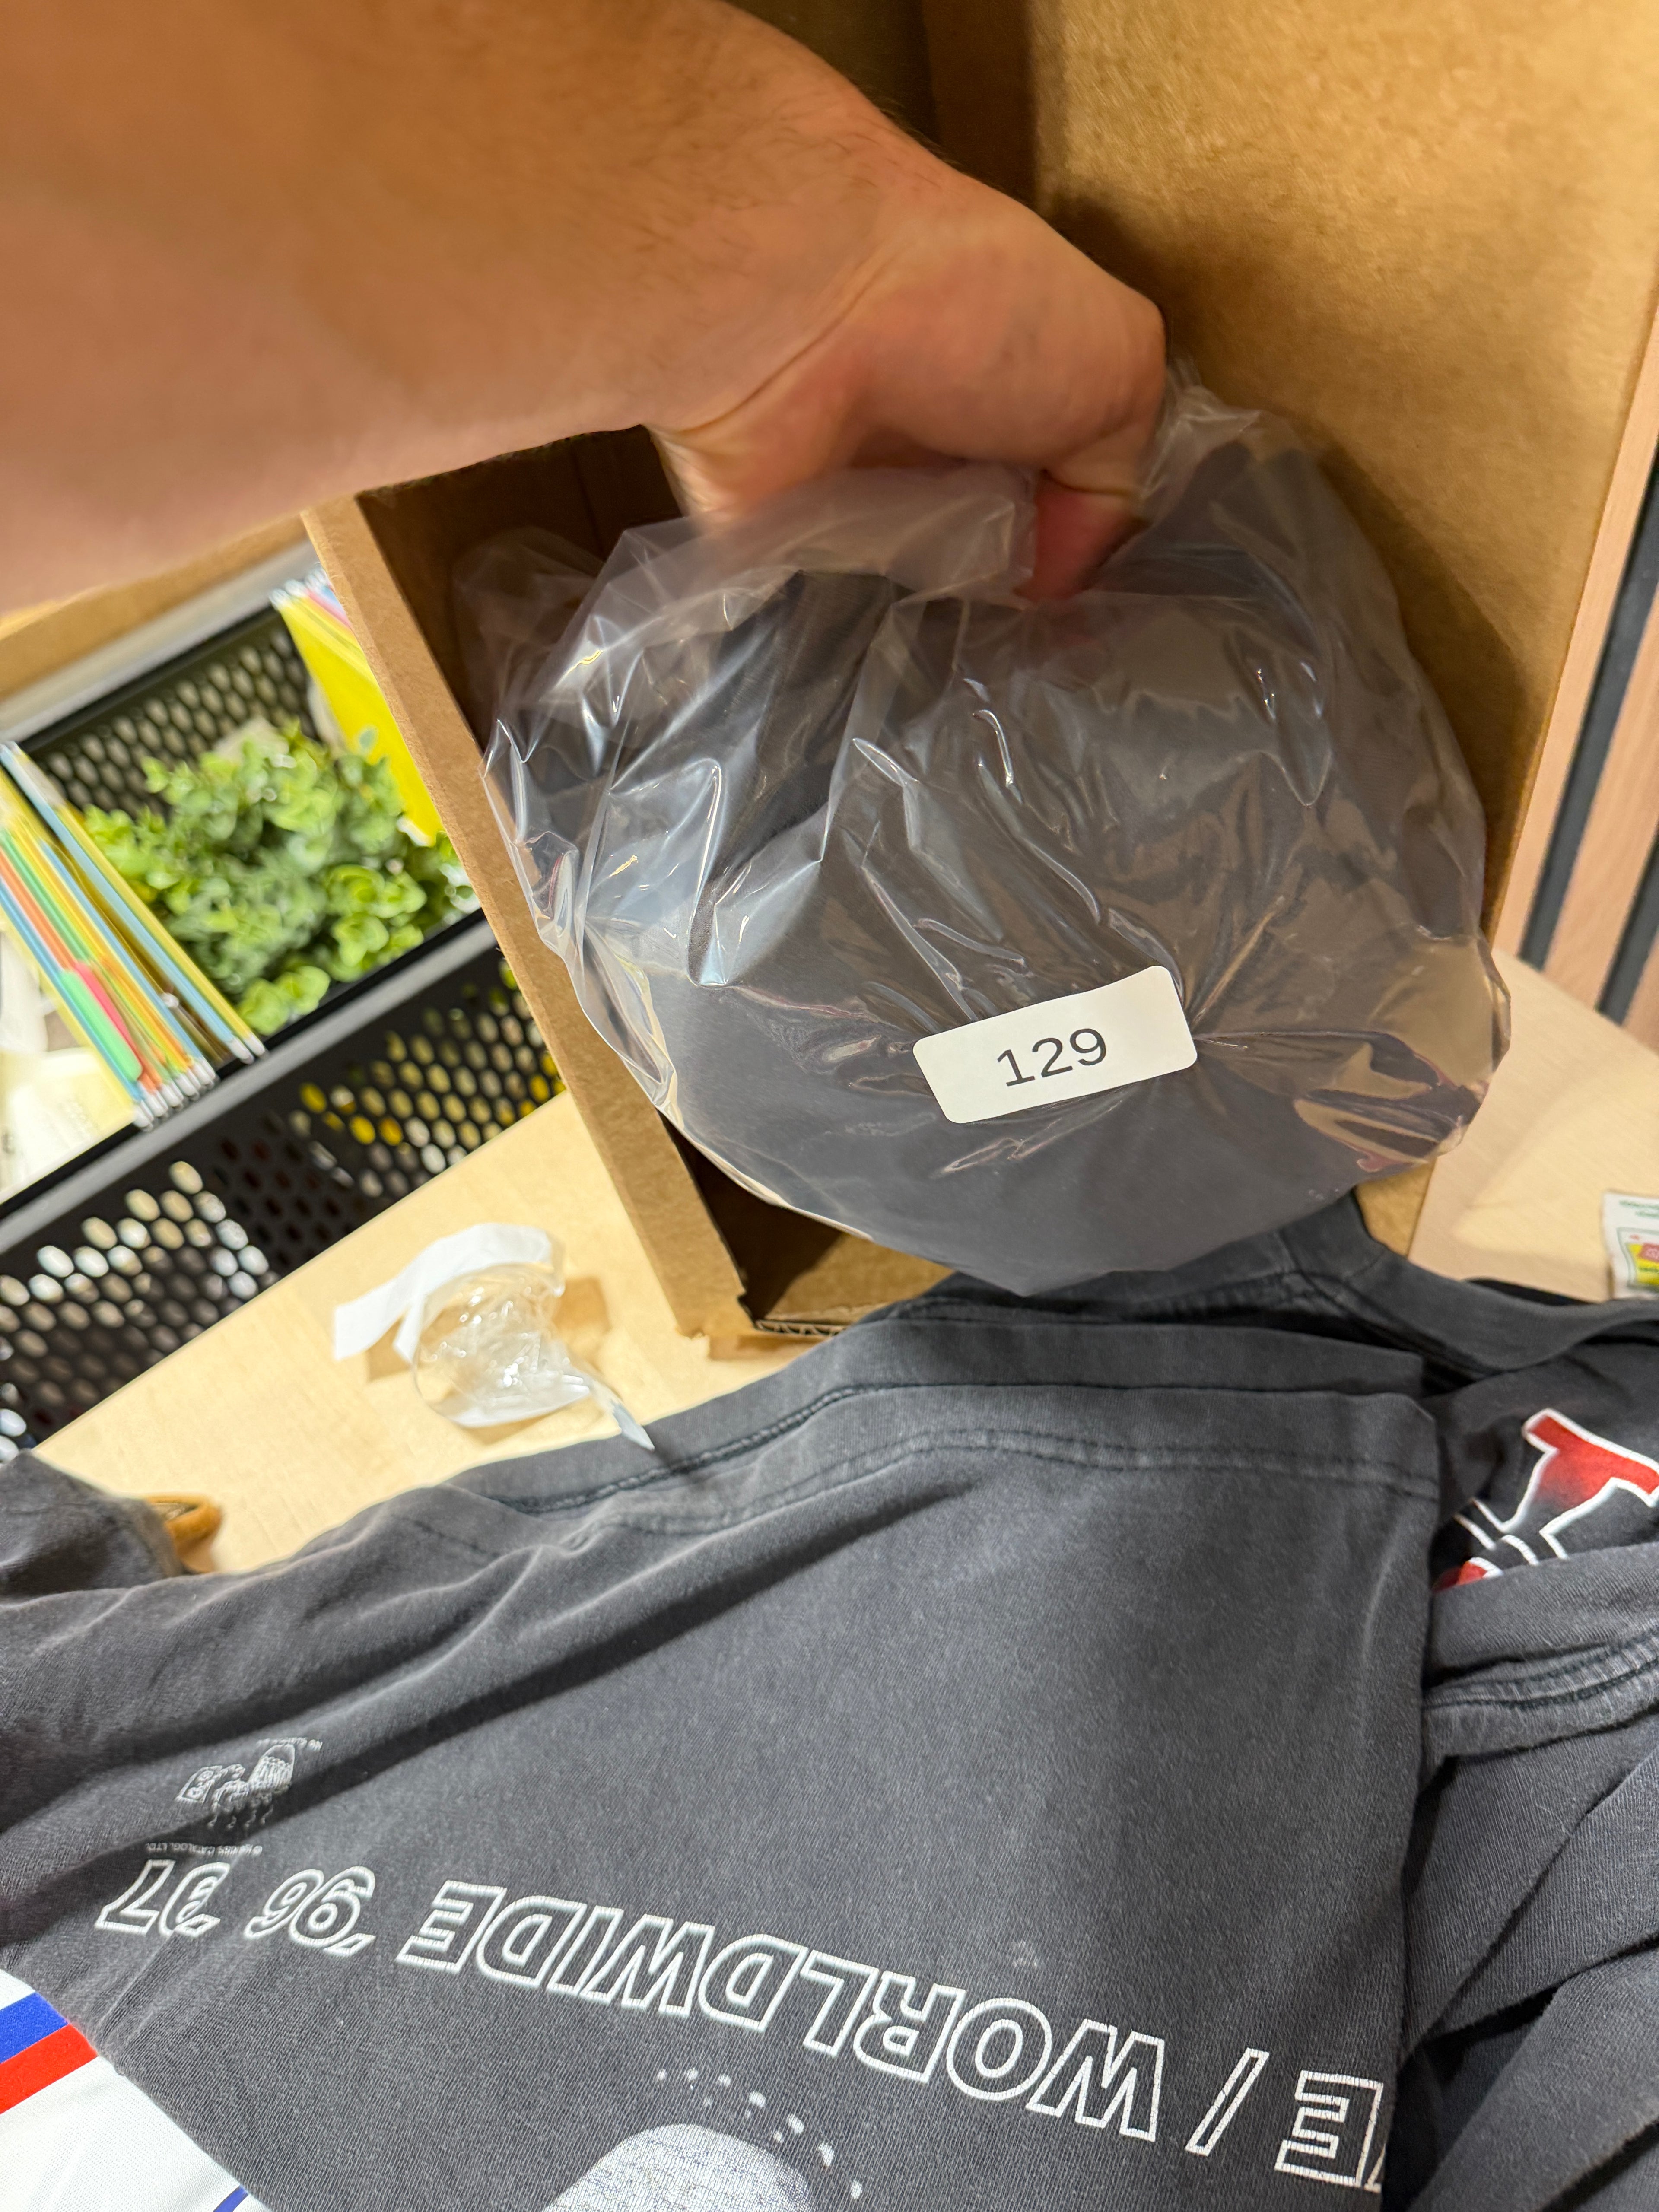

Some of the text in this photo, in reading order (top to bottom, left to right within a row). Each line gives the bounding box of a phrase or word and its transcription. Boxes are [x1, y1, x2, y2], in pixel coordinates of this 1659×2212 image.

[996, 1028, 1107, 1087] 129
[243, 1865, 377, 1957] '96
[396, 1881, 1165, 2142] WORLDWIDE
[1274, 2070, 1387, 2193] E
